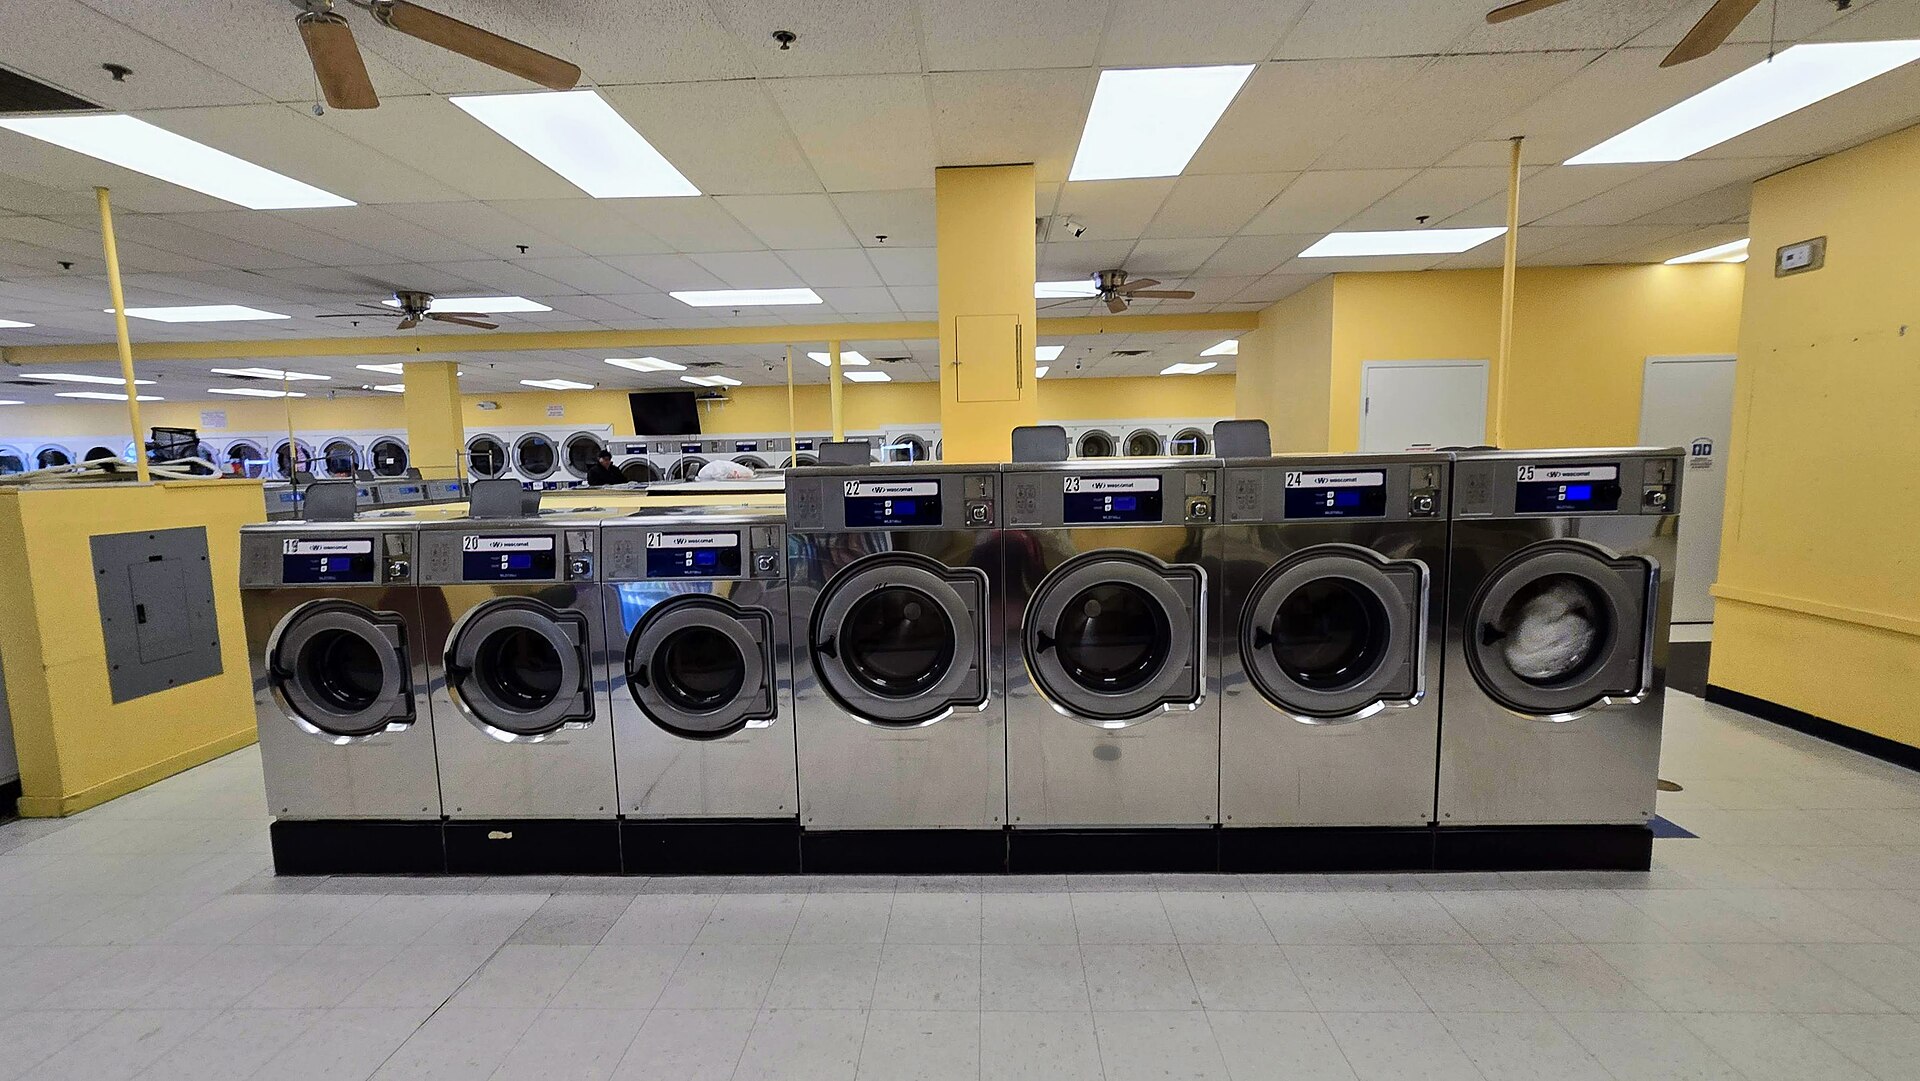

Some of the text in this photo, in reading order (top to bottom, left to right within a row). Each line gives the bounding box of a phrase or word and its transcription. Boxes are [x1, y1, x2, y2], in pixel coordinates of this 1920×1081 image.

[1287, 472, 1302, 487] 24
[1518, 466, 1534, 481] 25
[845, 481, 860, 496] 22
[1065, 477, 1080, 492] 23
[284, 540, 299, 553] 19
[464, 536, 479, 550] 20
[647, 533, 662, 547] 21
